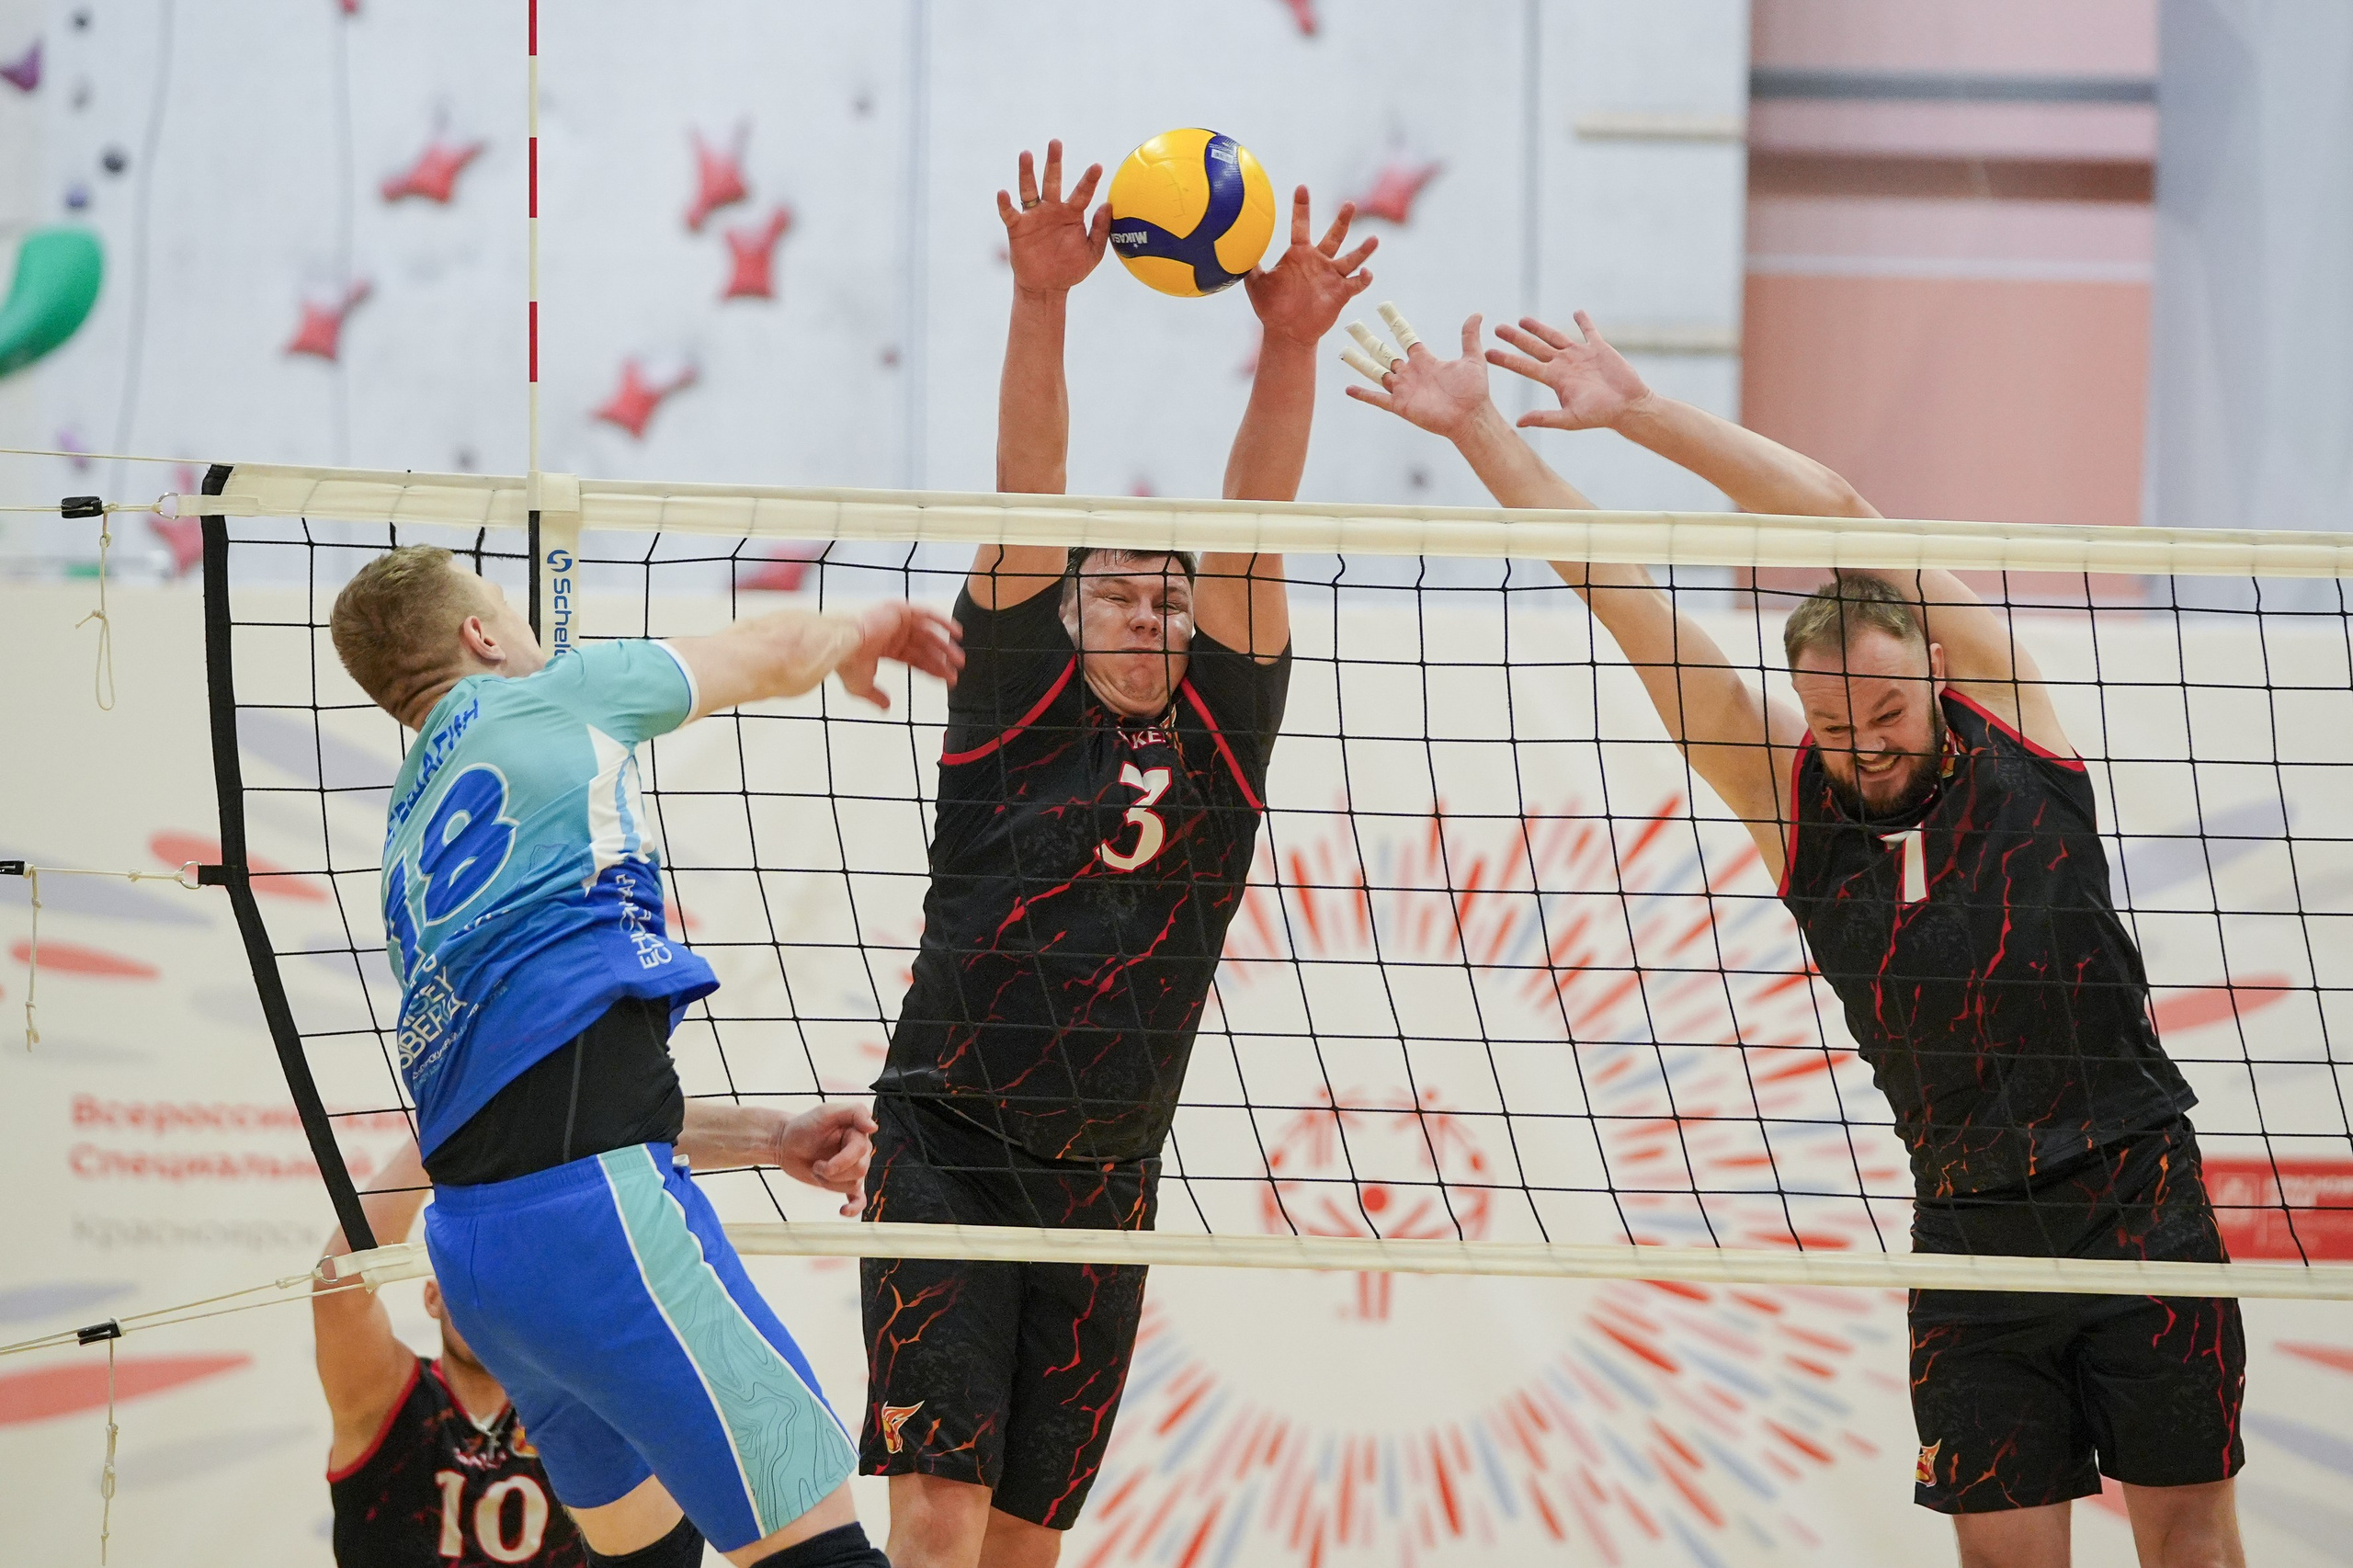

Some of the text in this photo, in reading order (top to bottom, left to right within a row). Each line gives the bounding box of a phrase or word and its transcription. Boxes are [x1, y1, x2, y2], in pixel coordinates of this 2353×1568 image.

[1092, 760, 1173, 872] 3
[1877, 821, 1931, 911] 1
[383, 762, 521, 987] 18
[435, 1468, 551, 1564] 10
